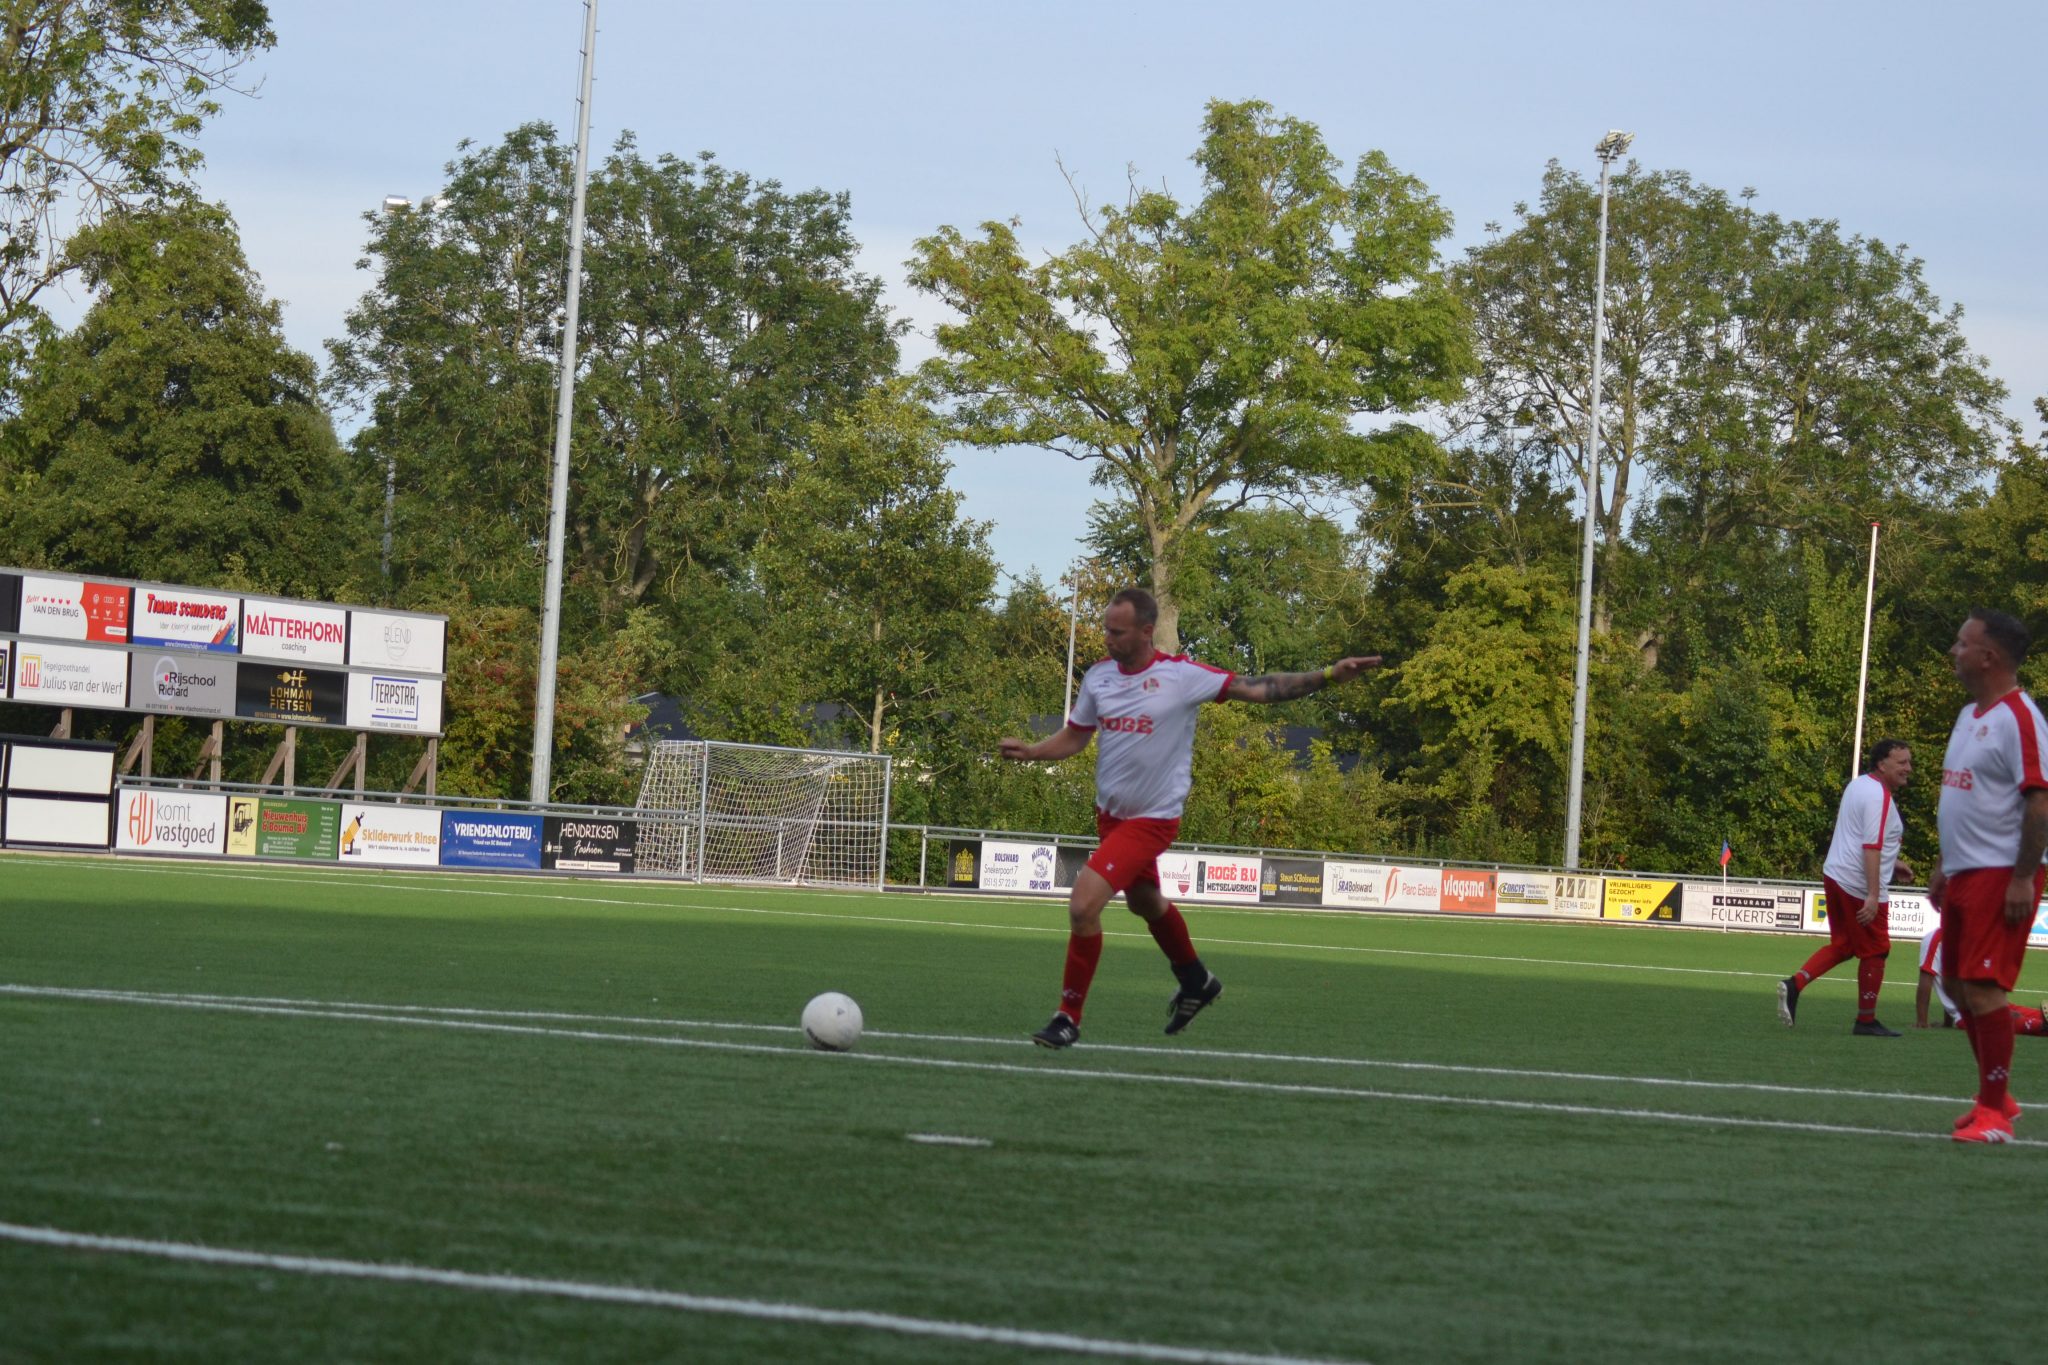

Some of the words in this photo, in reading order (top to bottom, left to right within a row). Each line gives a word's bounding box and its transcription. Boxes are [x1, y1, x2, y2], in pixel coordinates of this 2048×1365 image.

[33, 605, 47, 614] VAN
[47, 606, 61, 616] DEN
[62, 607, 79, 618] BRUG
[246, 610, 343, 644] MATTERHORN
[384, 626, 411, 644] BLEND
[281, 642, 307, 653] coaching
[44, 661, 90, 673] Tegelgroothandel
[42, 676, 66, 689] Julius
[69, 681, 83, 692] van
[86, 680, 99, 692] der
[102, 681, 123, 694] Werf
[169, 672, 216, 687] Rijschool
[159, 684, 188, 697] Richard
[270, 686, 312, 700] LOHMAN
[375, 683, 415, 706] TERPSTRA
[270, 698, 312, 712] FIETSEN
[156, 798, 191, 822] komt
[262, 809, 308, 823] Nieuwenhuis
[269, 822, 295, 833] Bouma
[454, 822, 532, 841] VRIENDENLOTERIJ
[561, 822, 619, 840] HENDRIKSEN
[155, 822, 215, 848] vastgoed
[362, 829, 413, 844] Skilderwurk
[414, 831, 437, 845] Rinse
[574, 839, 604, 856] Fashion
[994, 853, 1019, 863] BOLSWARD
[1031, 847, 1053, 864] MIEDEMA
[1014, 866, 1019, 874] 7
[1241, 867, 1258, 882] B.V.
[998, 878, 1004, 887] 57
[1004, 879, 1011, 887] 22
[1280, 873, 1294, 882] Steun
[1206, 882, 1257, 893] METSELWERKEN
[1418, 883, 1437, 897] Estate
[1443, 874, 1485, 902] vlagsma
[1608, 888, 1635, 896] GEZOCHT
[1609, 881, 1652, 890] VRIJWILLIGERS
[1580, 901, 1596, 910] BOUW
[1711, 907, 1774, 924] FOLKERTS
[1887, 911, 1924, 925] elaardij
